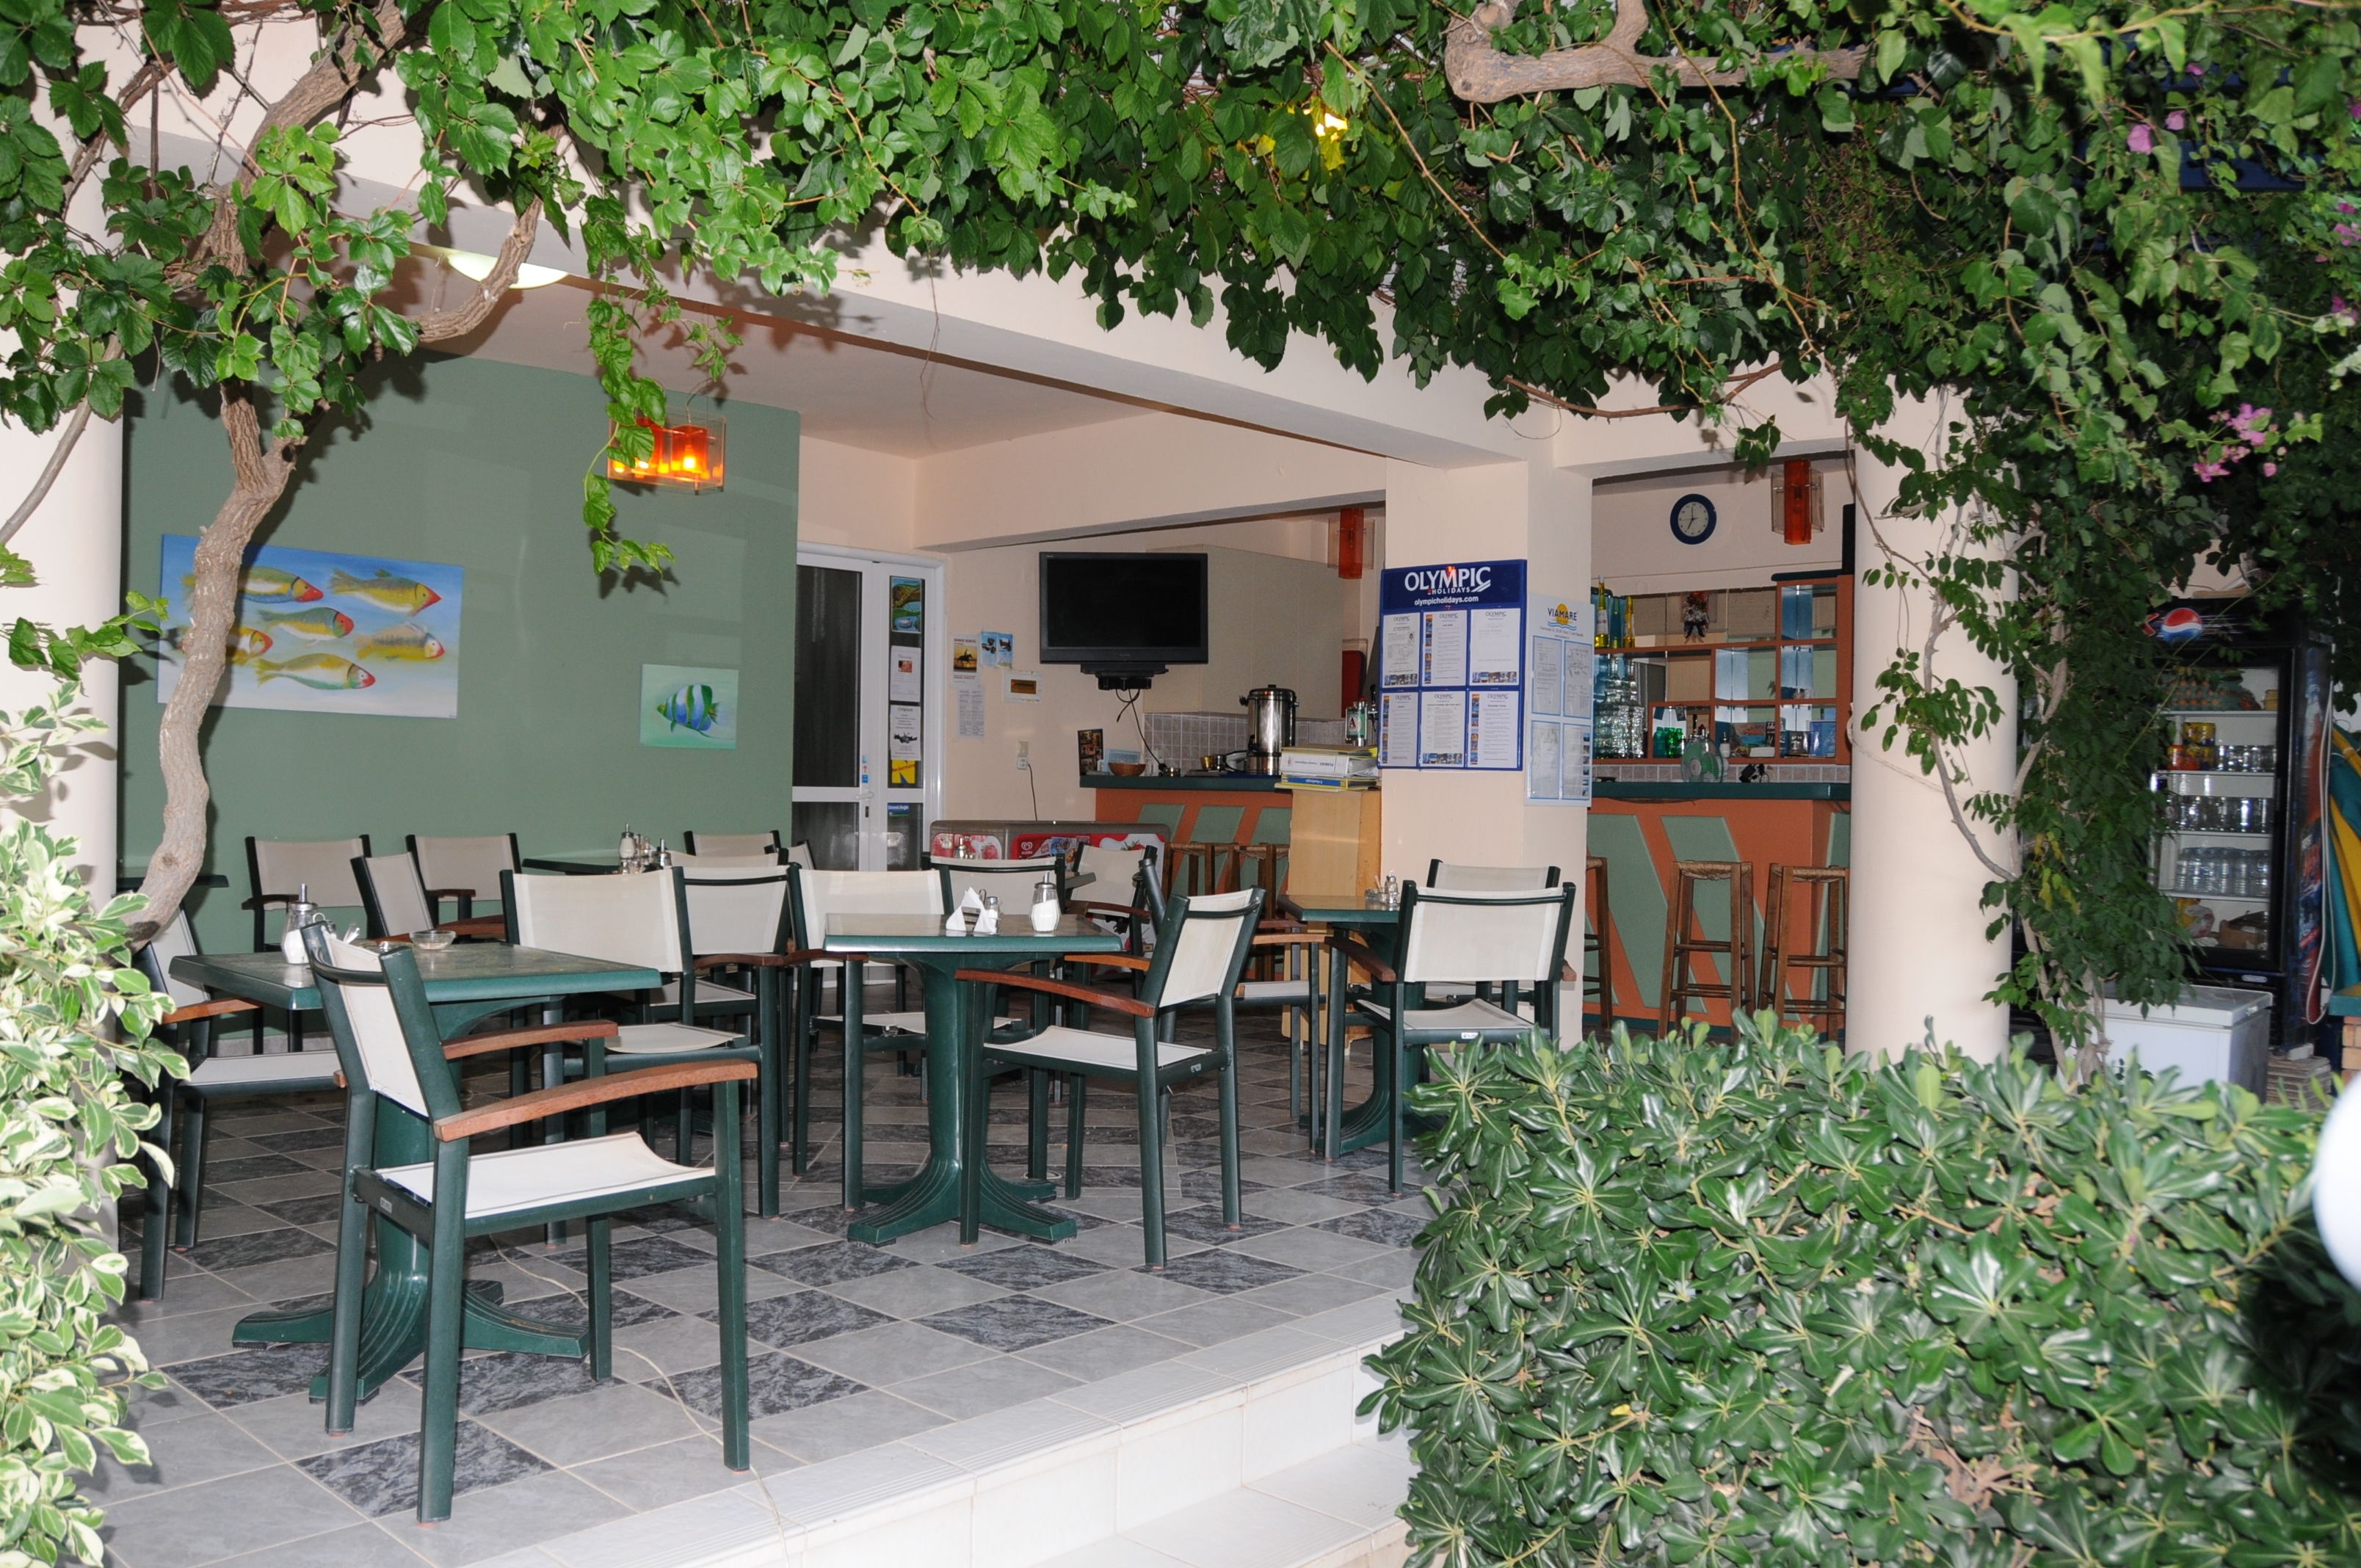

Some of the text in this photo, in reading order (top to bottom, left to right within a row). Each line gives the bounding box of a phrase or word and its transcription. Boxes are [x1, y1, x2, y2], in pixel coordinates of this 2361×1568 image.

[1404, 566, 1491, 592] OLYMPIC
[1432, 587, 1470, 595] HOLIDAYS
[1414, 595, 1479, 606] olympicholidays.com
[1547, 607, 1578, 621] VIAMARE
